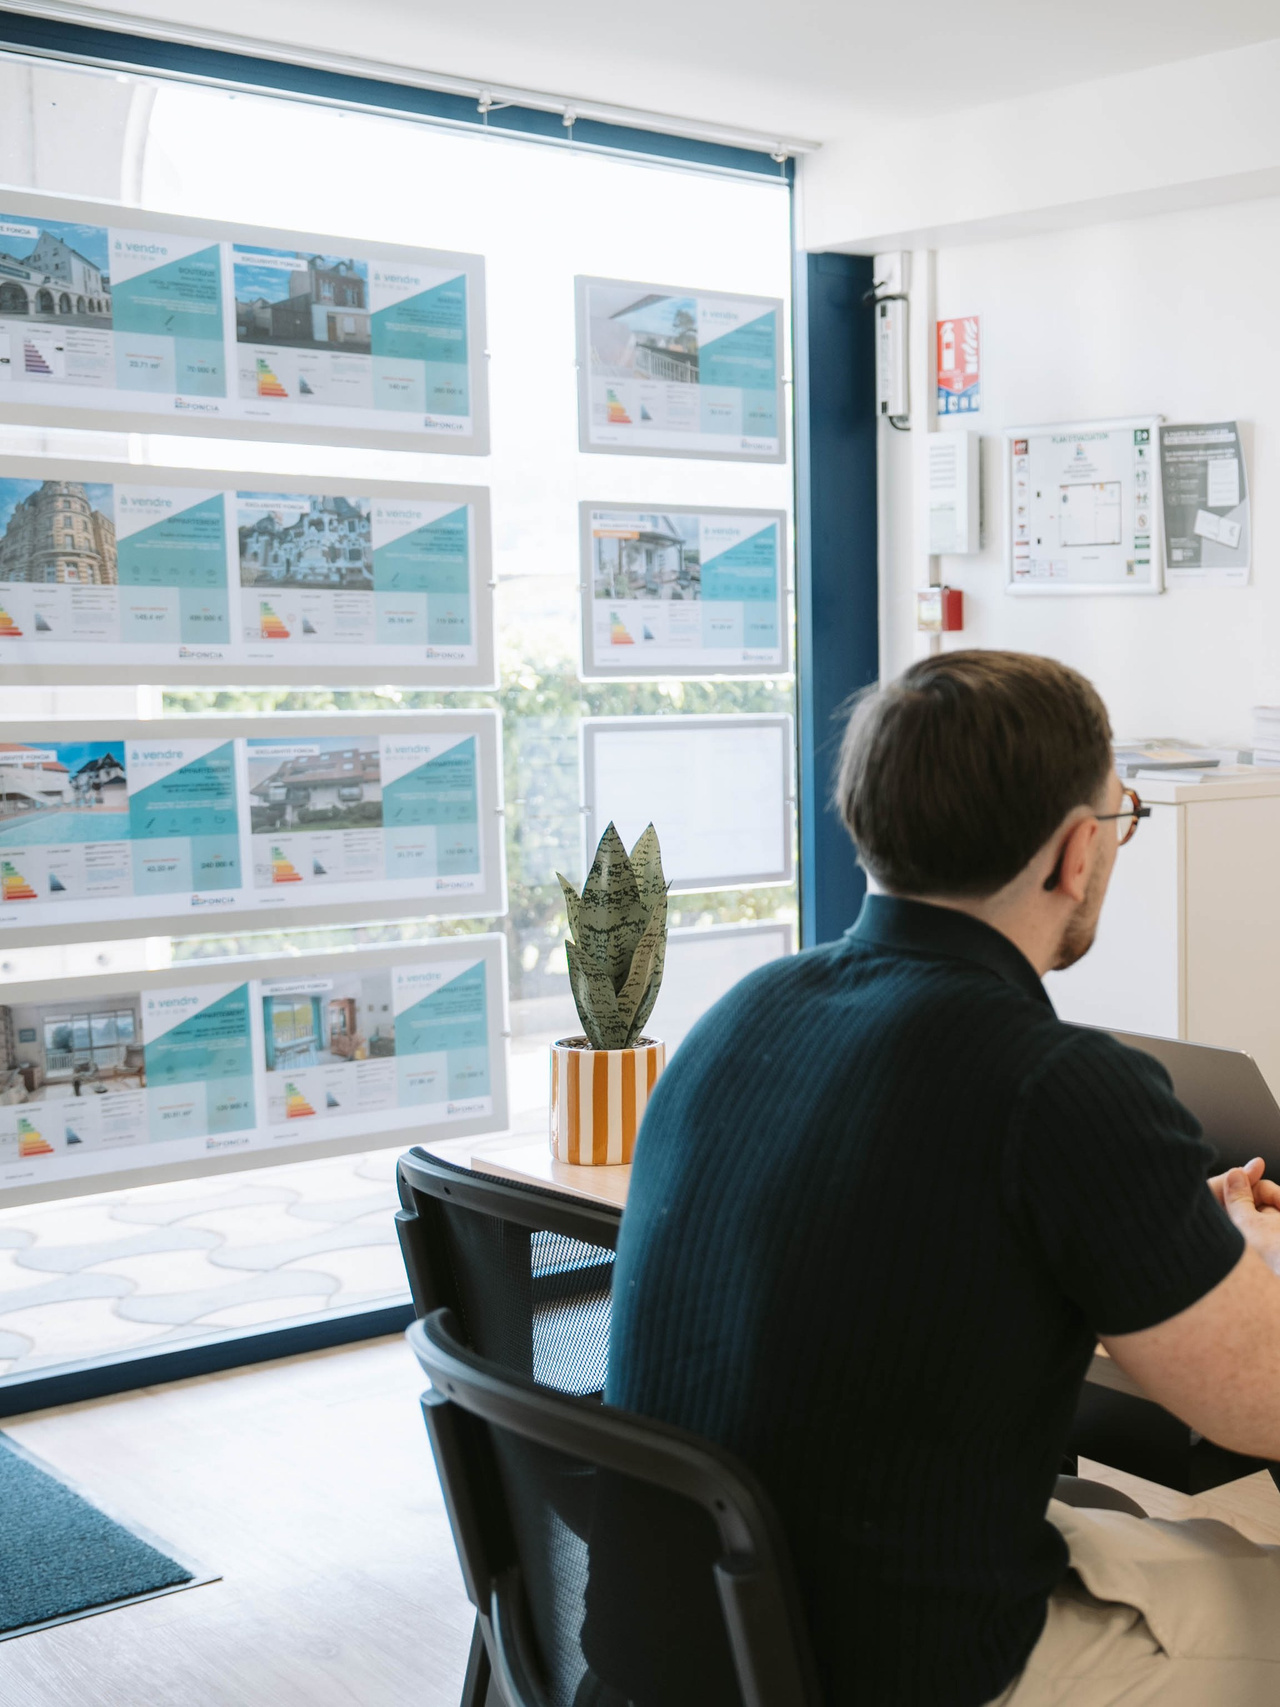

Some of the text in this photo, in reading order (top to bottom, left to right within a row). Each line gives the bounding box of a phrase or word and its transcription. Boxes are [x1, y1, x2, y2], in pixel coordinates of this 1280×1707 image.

[126, 242, 168, 256] vendre
[384, 273, 421, 286] vendre
[131, 497, 172, 507] vendre
[386, 507, 422, 518] vendre
[394, 744, 431, 754] vendre
[143, 749, 183, 761] vendre
[158, 997, 199, 1008] vendre
